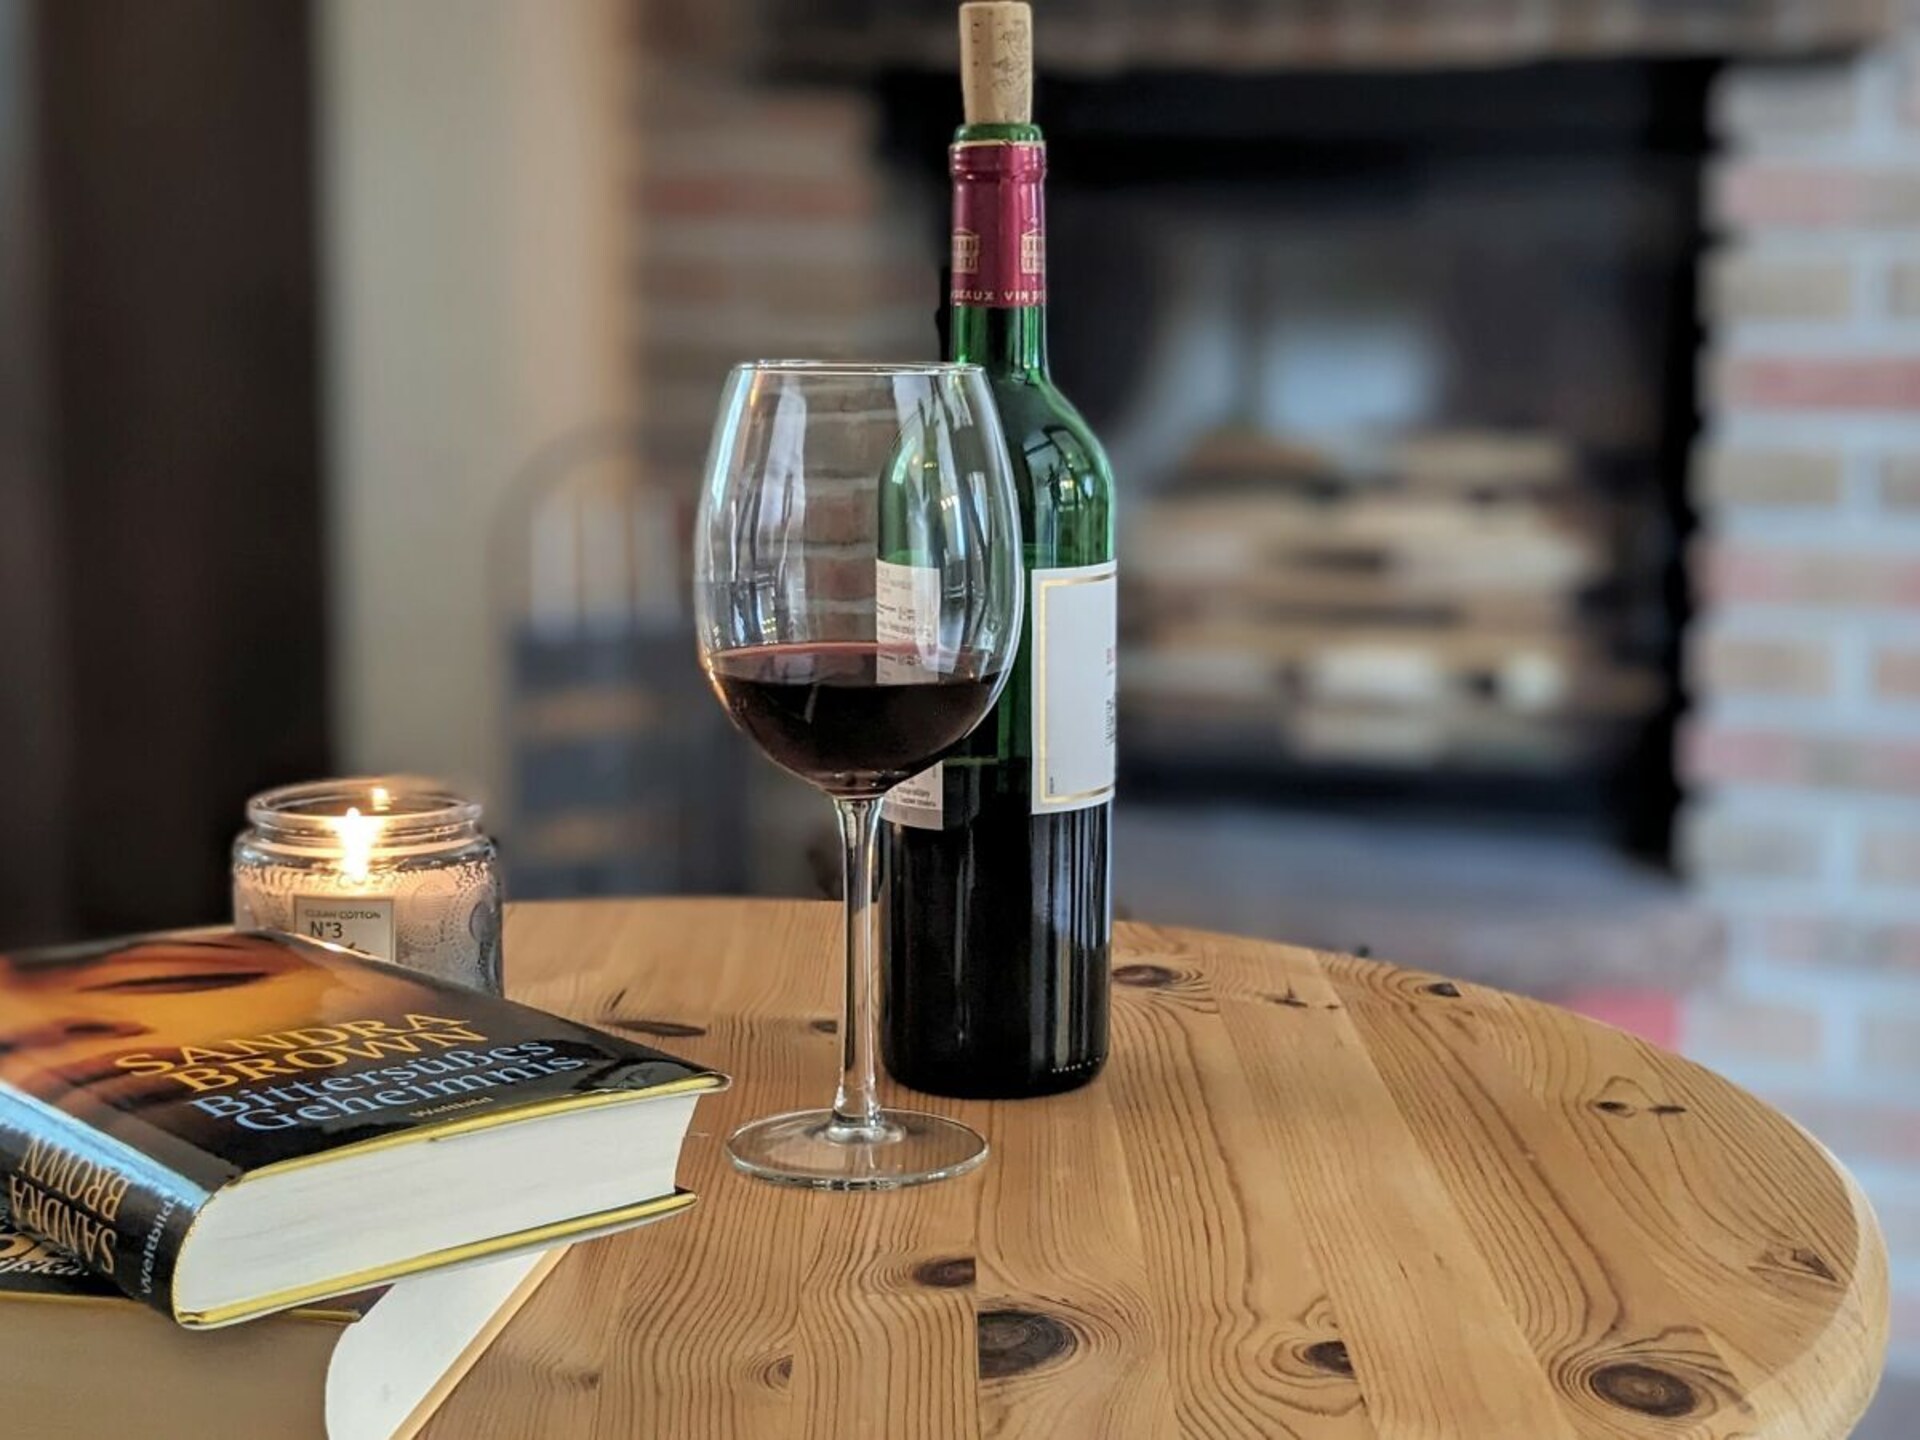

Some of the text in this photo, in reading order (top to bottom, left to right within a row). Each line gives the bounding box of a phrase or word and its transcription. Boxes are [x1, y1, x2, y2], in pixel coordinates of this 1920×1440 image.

[340, 909, 382, 920] COTTON
[114, 1013, 471, 1077] SANDRA
[163, 1027, 488, 1094] BROWN
[188, 1041, 556, 1120] Bittersüßes
[235, 1056, 586, 1131] Geheimnis
[18, 1136, 131, 1222] BROWN
[10, 1175, 117, 1275] SANDRA
[140, 1199, 176, 1294] Weltbild
